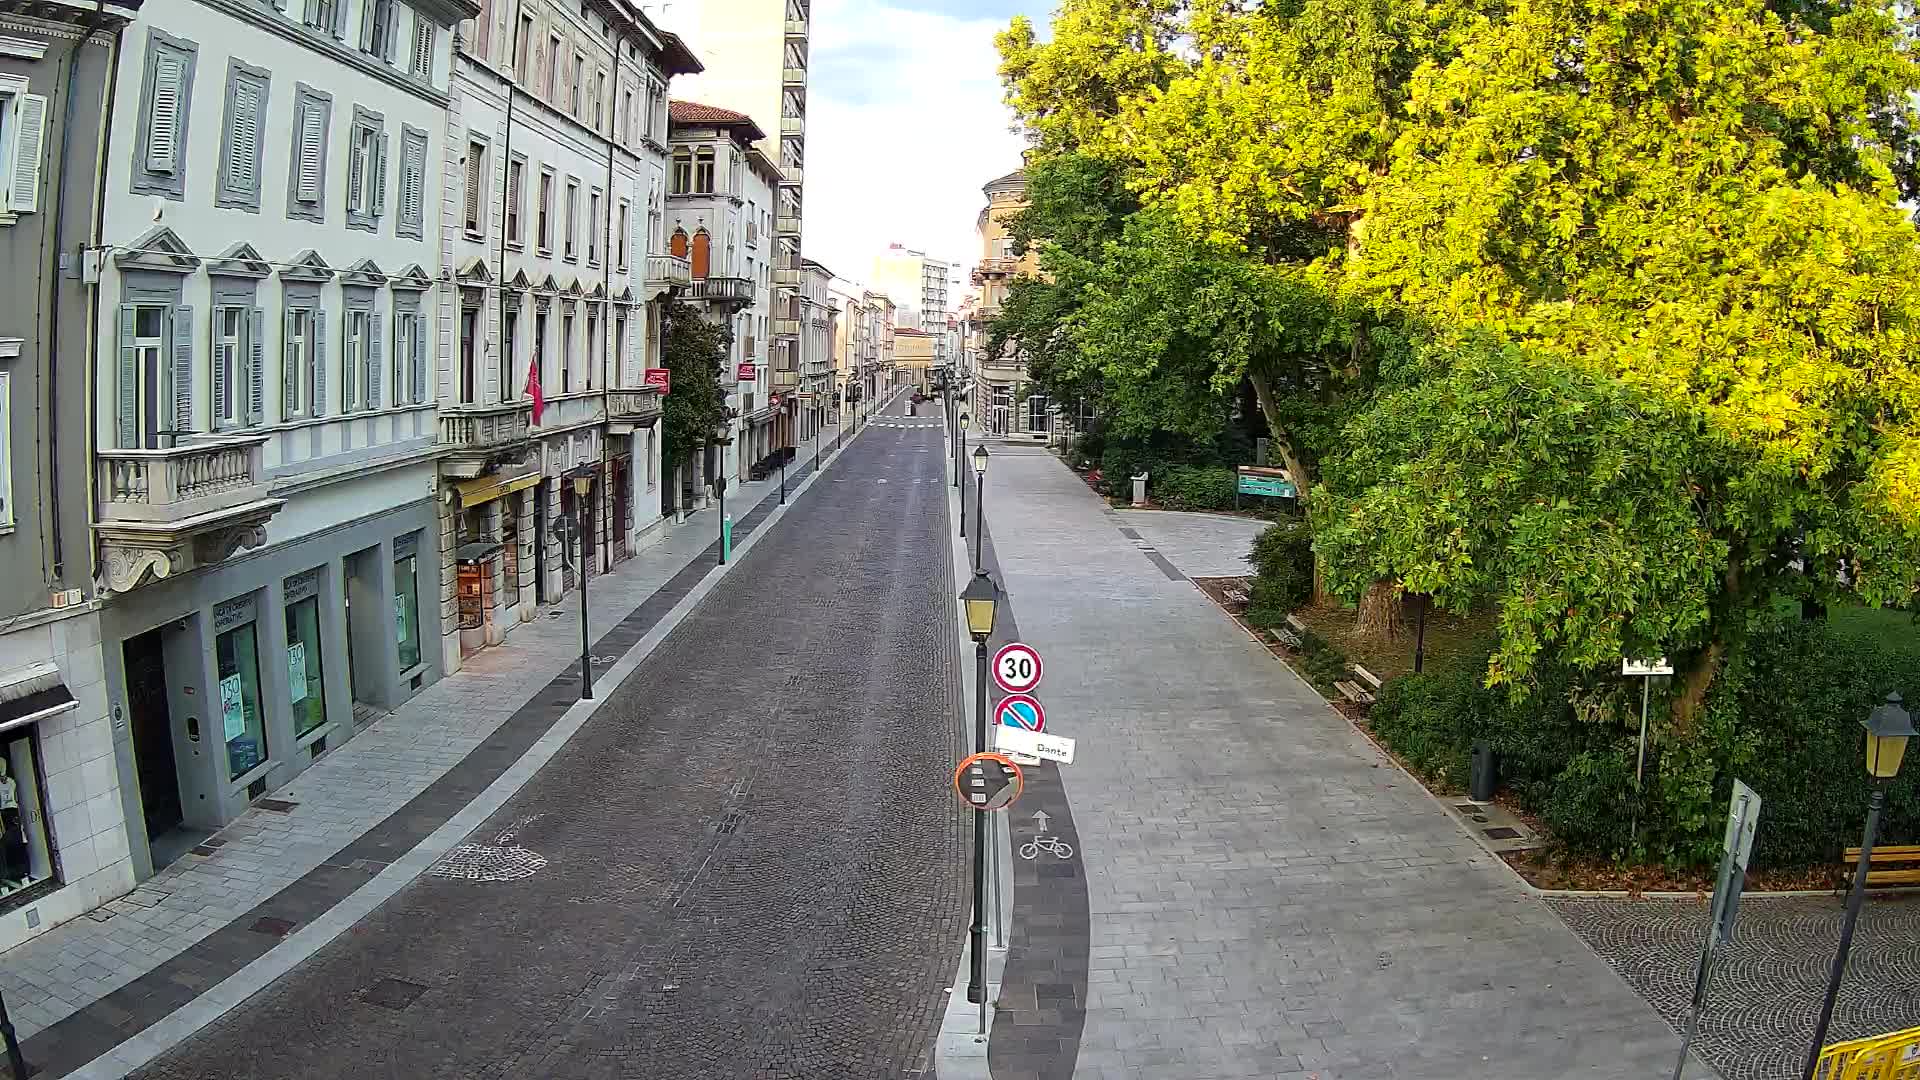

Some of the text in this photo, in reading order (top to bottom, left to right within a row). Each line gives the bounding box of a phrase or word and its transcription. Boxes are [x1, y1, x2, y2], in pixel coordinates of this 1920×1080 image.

[1005, 658, 1031, 679] 30
[220, 678, 240, 702] 130
[1037, 743, 1067, 757] Dante
